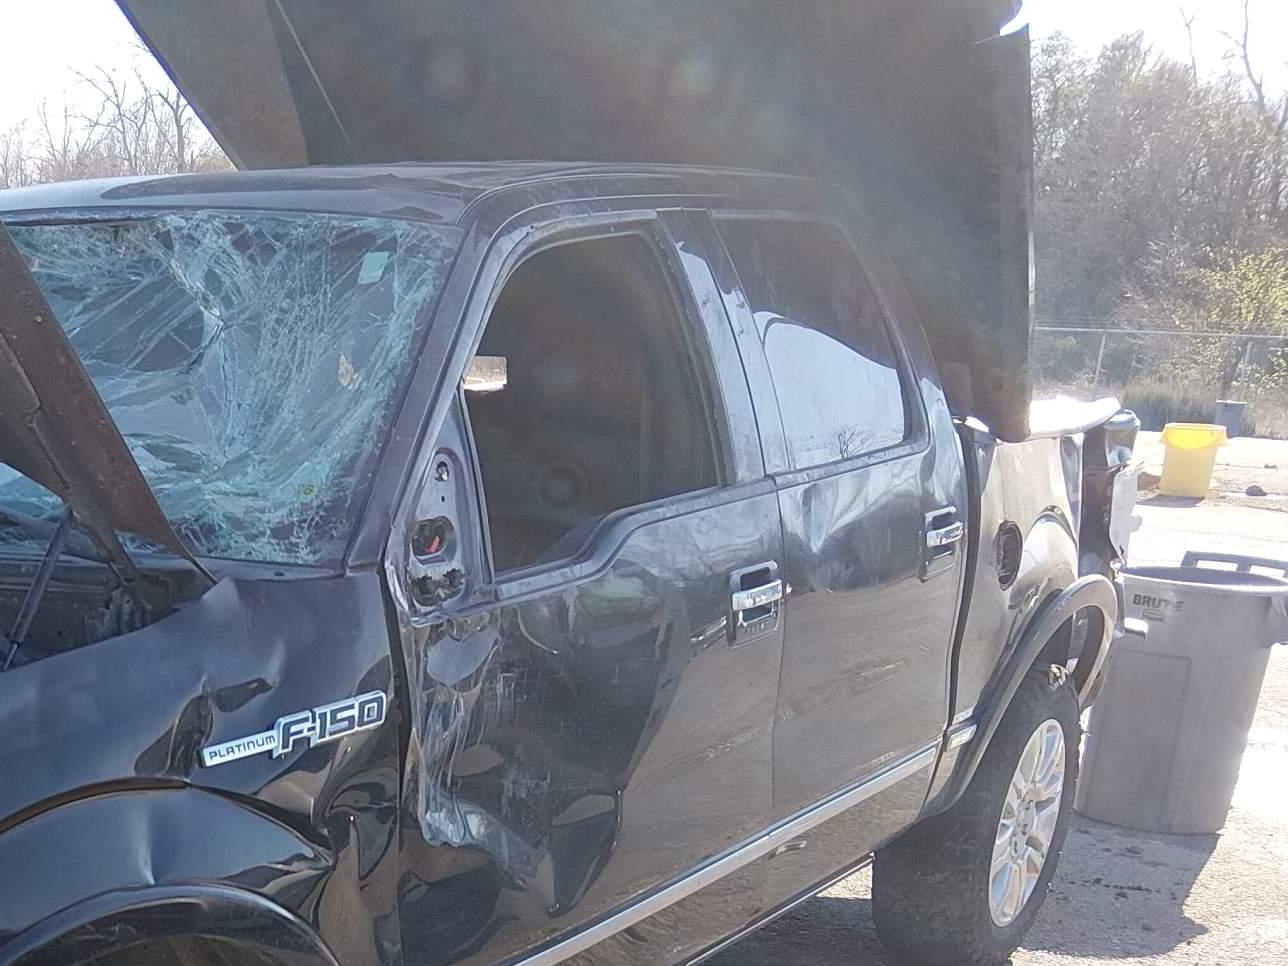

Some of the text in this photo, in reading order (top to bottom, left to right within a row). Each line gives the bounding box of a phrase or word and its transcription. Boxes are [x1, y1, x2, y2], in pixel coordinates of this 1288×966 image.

[1133, 594, 1184, 612] BRUTE
[209, 691, 386, 760] PLATINUM F-150
